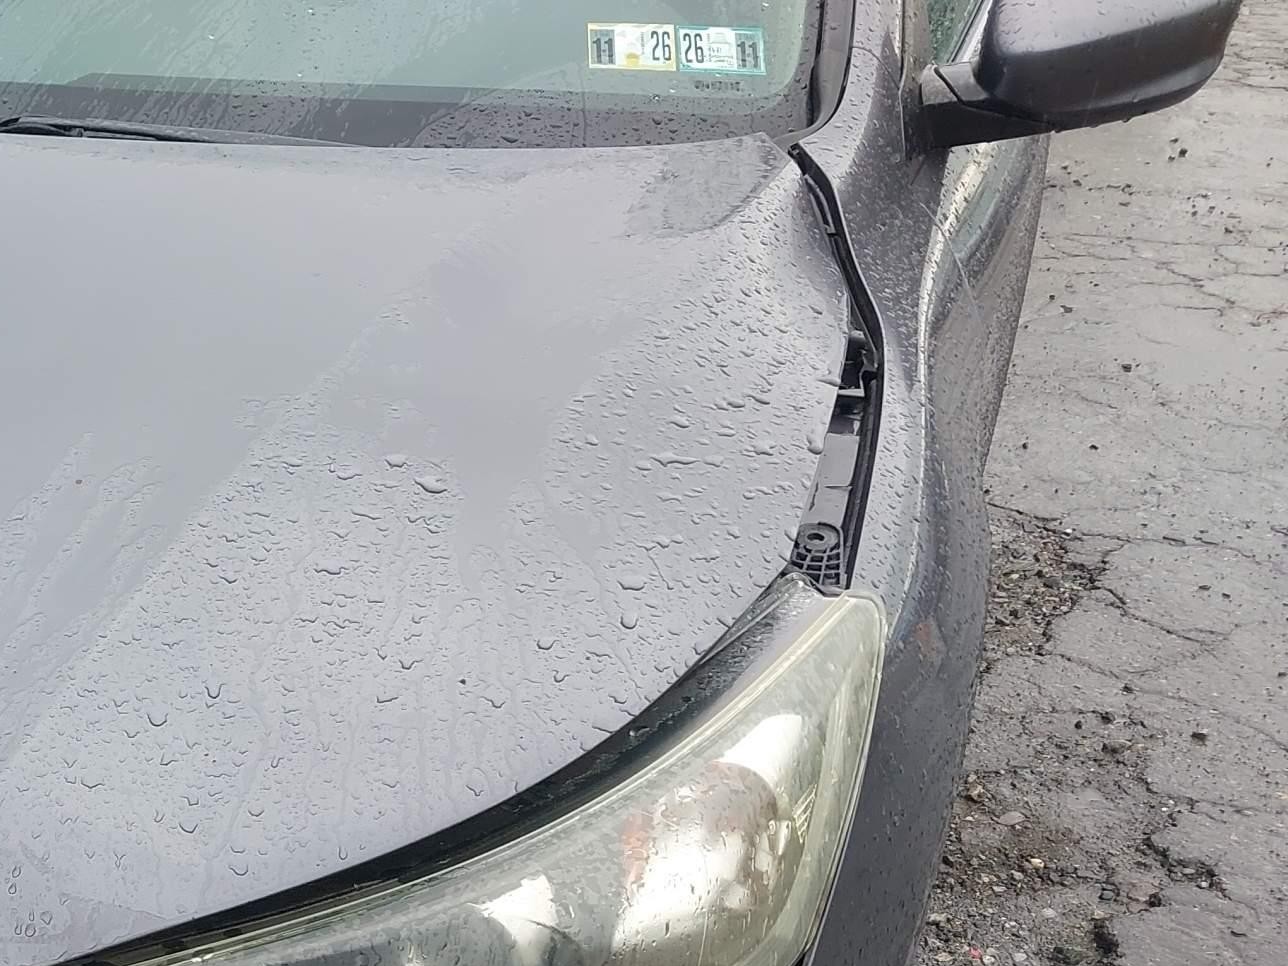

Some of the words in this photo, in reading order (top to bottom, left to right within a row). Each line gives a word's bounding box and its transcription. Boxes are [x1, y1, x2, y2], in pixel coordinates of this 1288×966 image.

[592, 38, 614, 64] 11
[650, 30, 672, 61] 26
[683, 32, 705, 63] 26
[736, 40, 759, 68] 11
